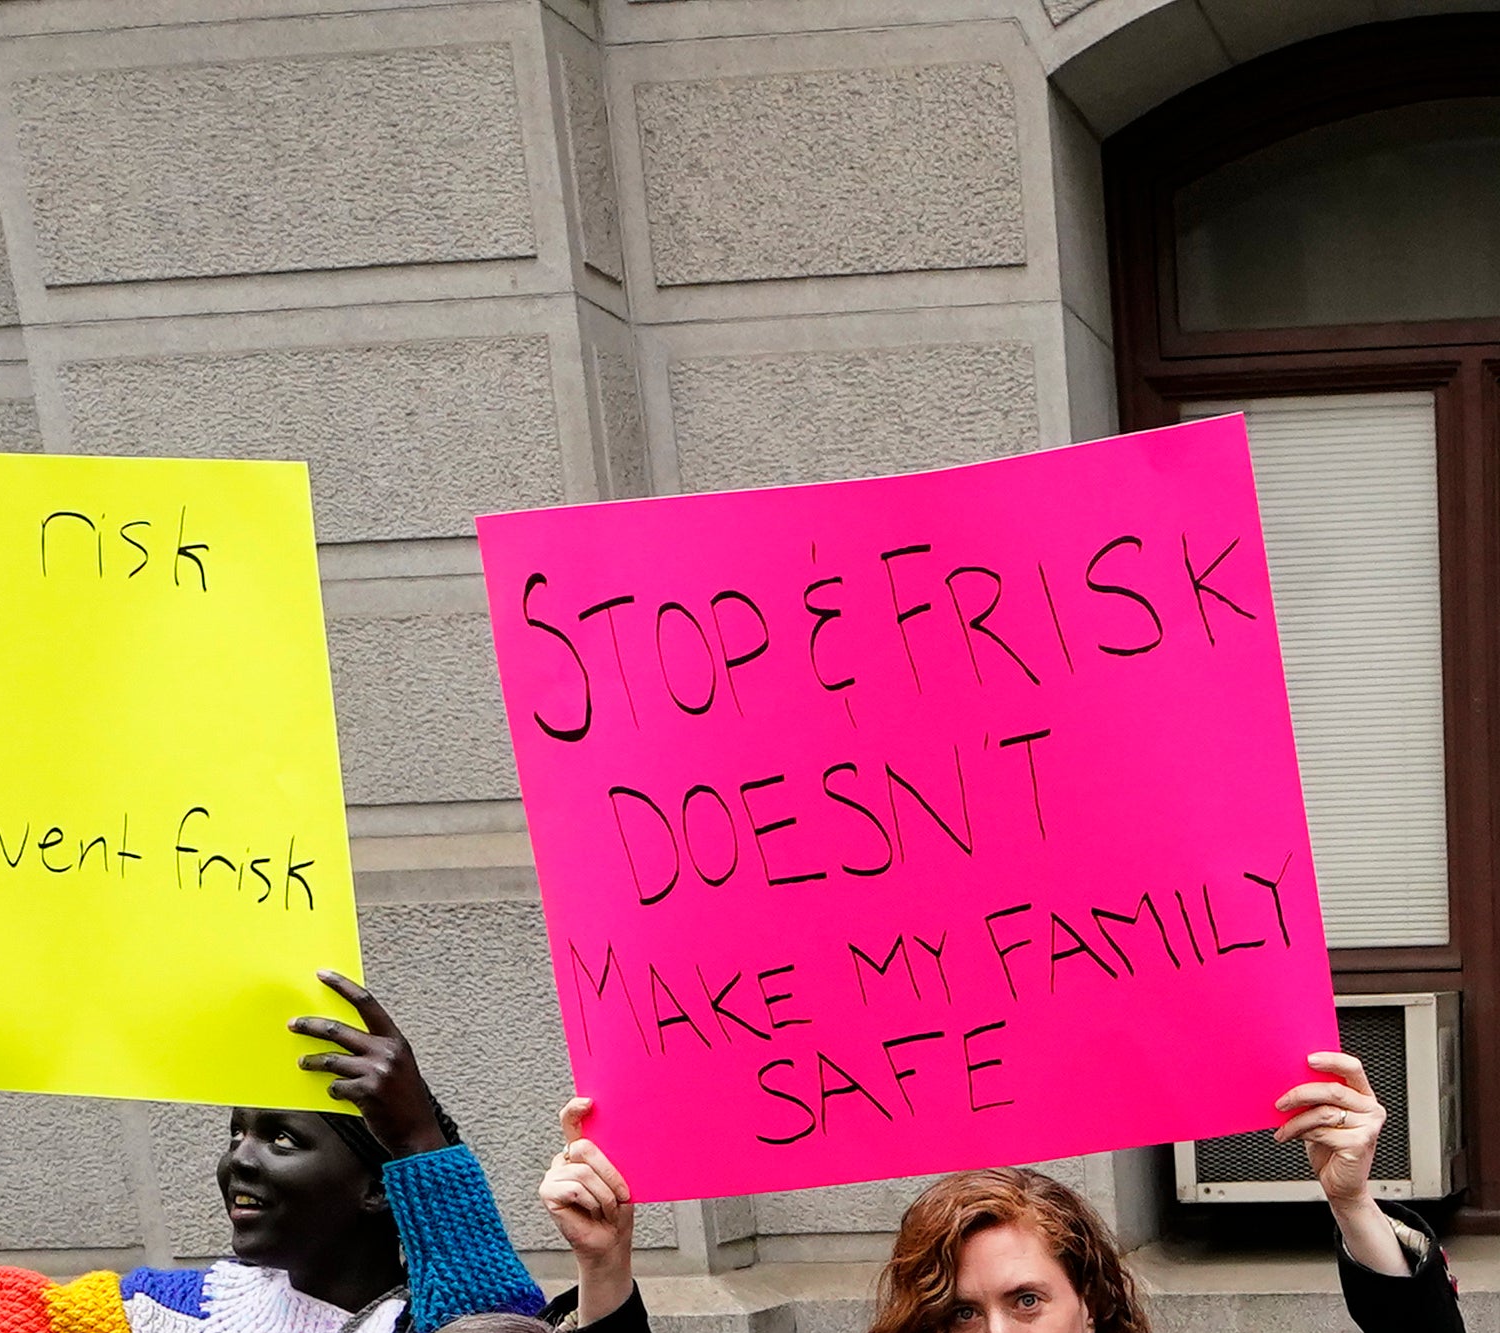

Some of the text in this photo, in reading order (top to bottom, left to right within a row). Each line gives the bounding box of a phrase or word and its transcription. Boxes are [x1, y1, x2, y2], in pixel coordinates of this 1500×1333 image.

[41, 505, 210, 593] risk
[522, 572, 771, 744] STOP
[881, 534, 1257, 693] FRISK
[173, 806, 315, 911] frisk
[608, 728, 1052, 907] DOESN'T
[568, 851, 1294, 1057] MAKE MY FAMILY
[754, 1019, 1015, 1145] SAFE
